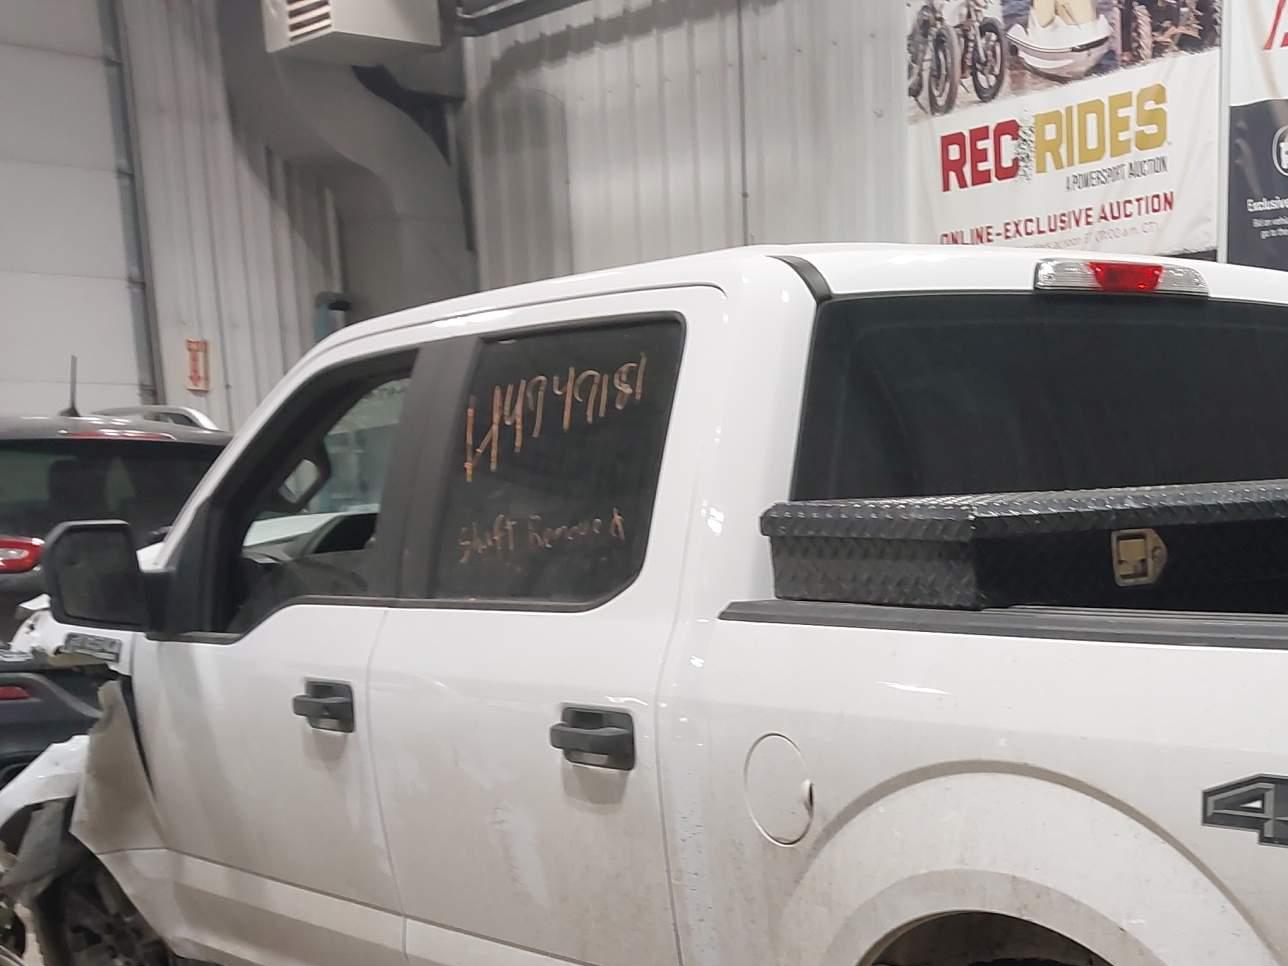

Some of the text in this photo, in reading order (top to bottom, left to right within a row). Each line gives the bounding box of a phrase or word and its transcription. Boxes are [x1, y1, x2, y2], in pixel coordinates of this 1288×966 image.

[940, 83, 1168, 193] REC RIDES
[1072, 163, 1126, 190] POWERSPORT
[1128, 156, 1168, 179] AUCTION
[940, 207, 1094, 244] ONLINE-EXCLUSIVE
[1099, 191, 1175, 222] AUCTION
